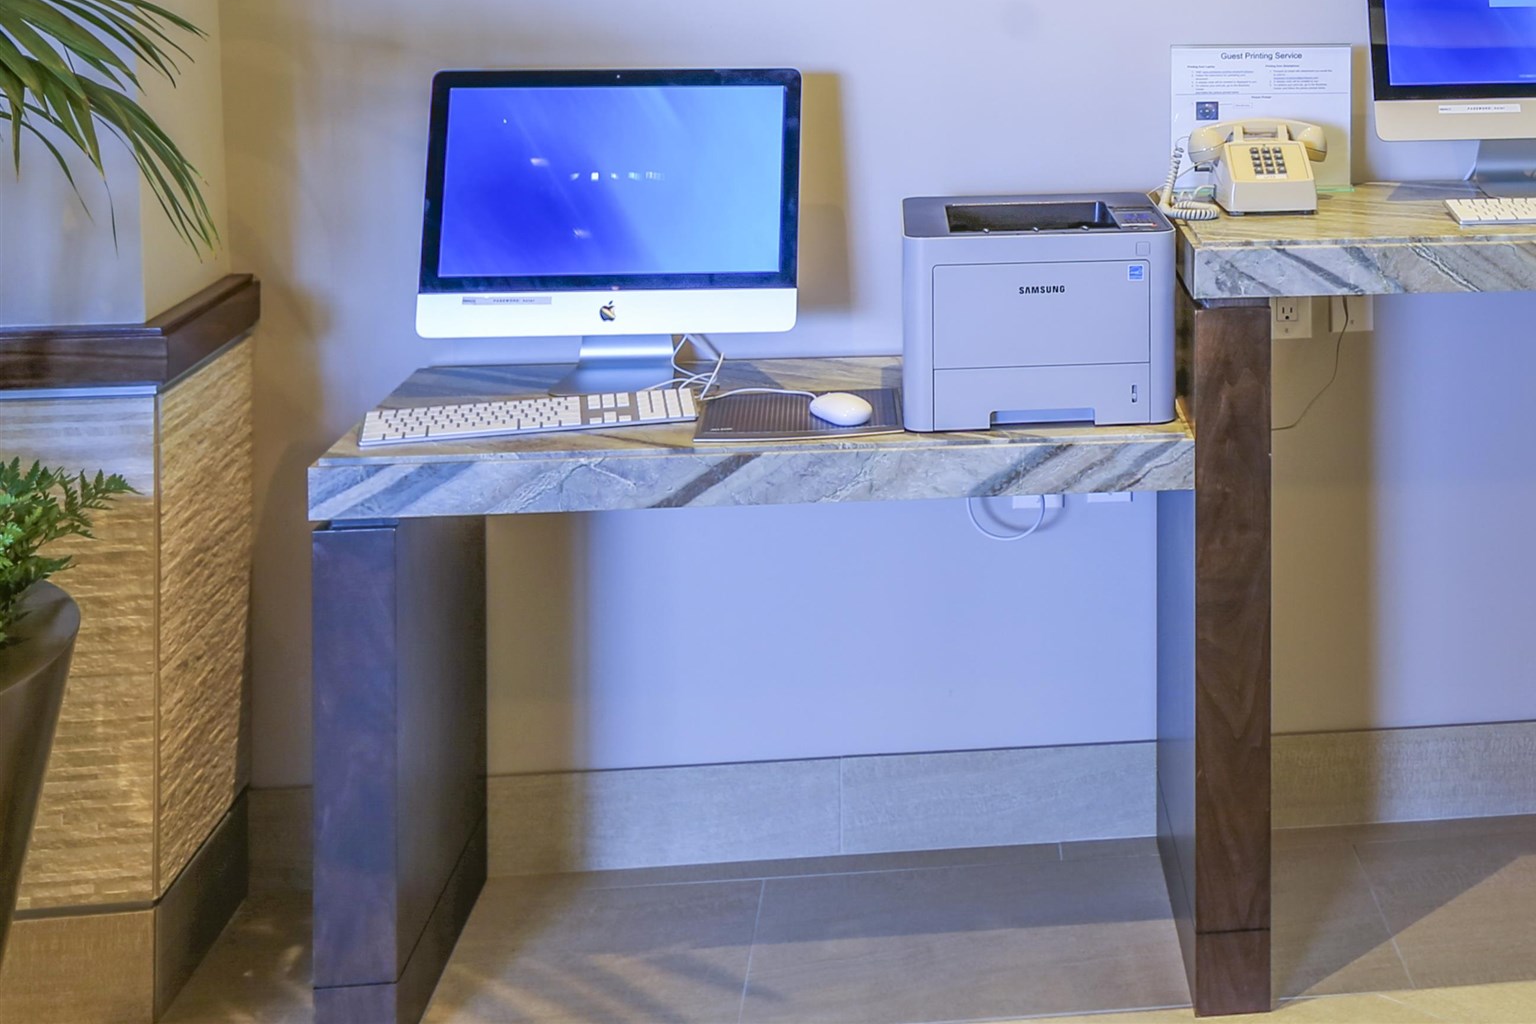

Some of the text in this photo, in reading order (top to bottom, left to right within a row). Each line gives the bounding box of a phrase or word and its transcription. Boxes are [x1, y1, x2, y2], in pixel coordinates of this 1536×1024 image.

[1220, 51, 1303, 60] Guest Printing Service
[1018, 285, 1065, 294] SAMSUNG
